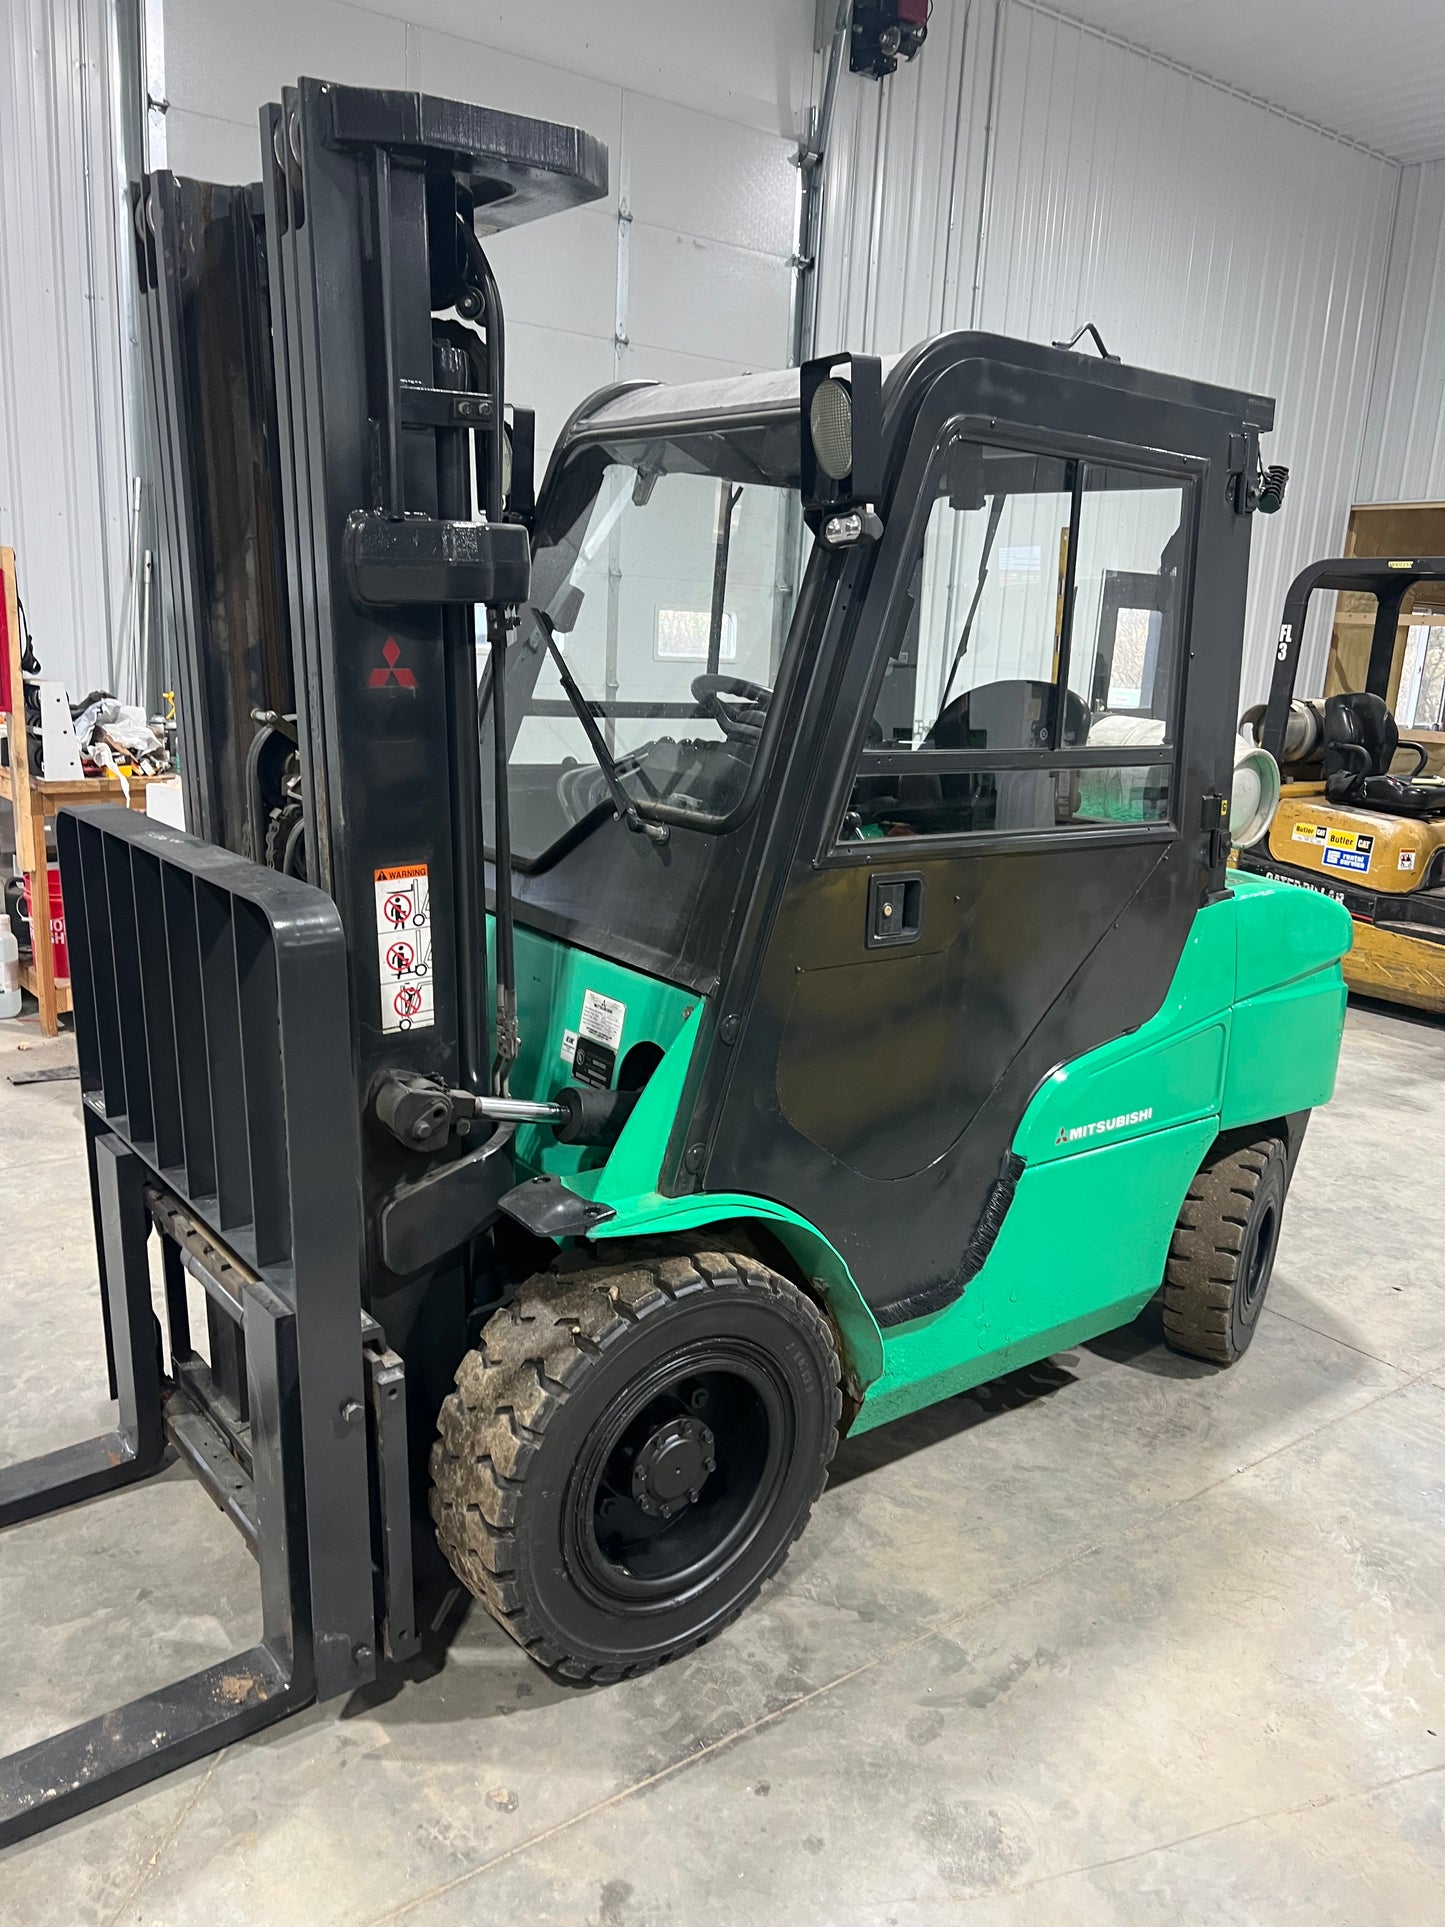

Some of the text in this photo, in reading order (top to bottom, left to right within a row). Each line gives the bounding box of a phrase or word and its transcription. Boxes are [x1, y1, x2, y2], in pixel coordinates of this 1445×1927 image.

[1279, 624, 1292, 642] FL
[1277, 642, 1287, 661] 3
[1296, 825, 1326, 836] Butler CAT
[1330, 834, 1354, 846] Butler
[1357, 839, 1371, 850] CAT
[1340, 859, 1365, 869] service
[1342, 853, 1365, 863] rental
[389, 868, 426, 879] WARNING
[1069, 1107, 1153, 1141] MITSUBISHI
